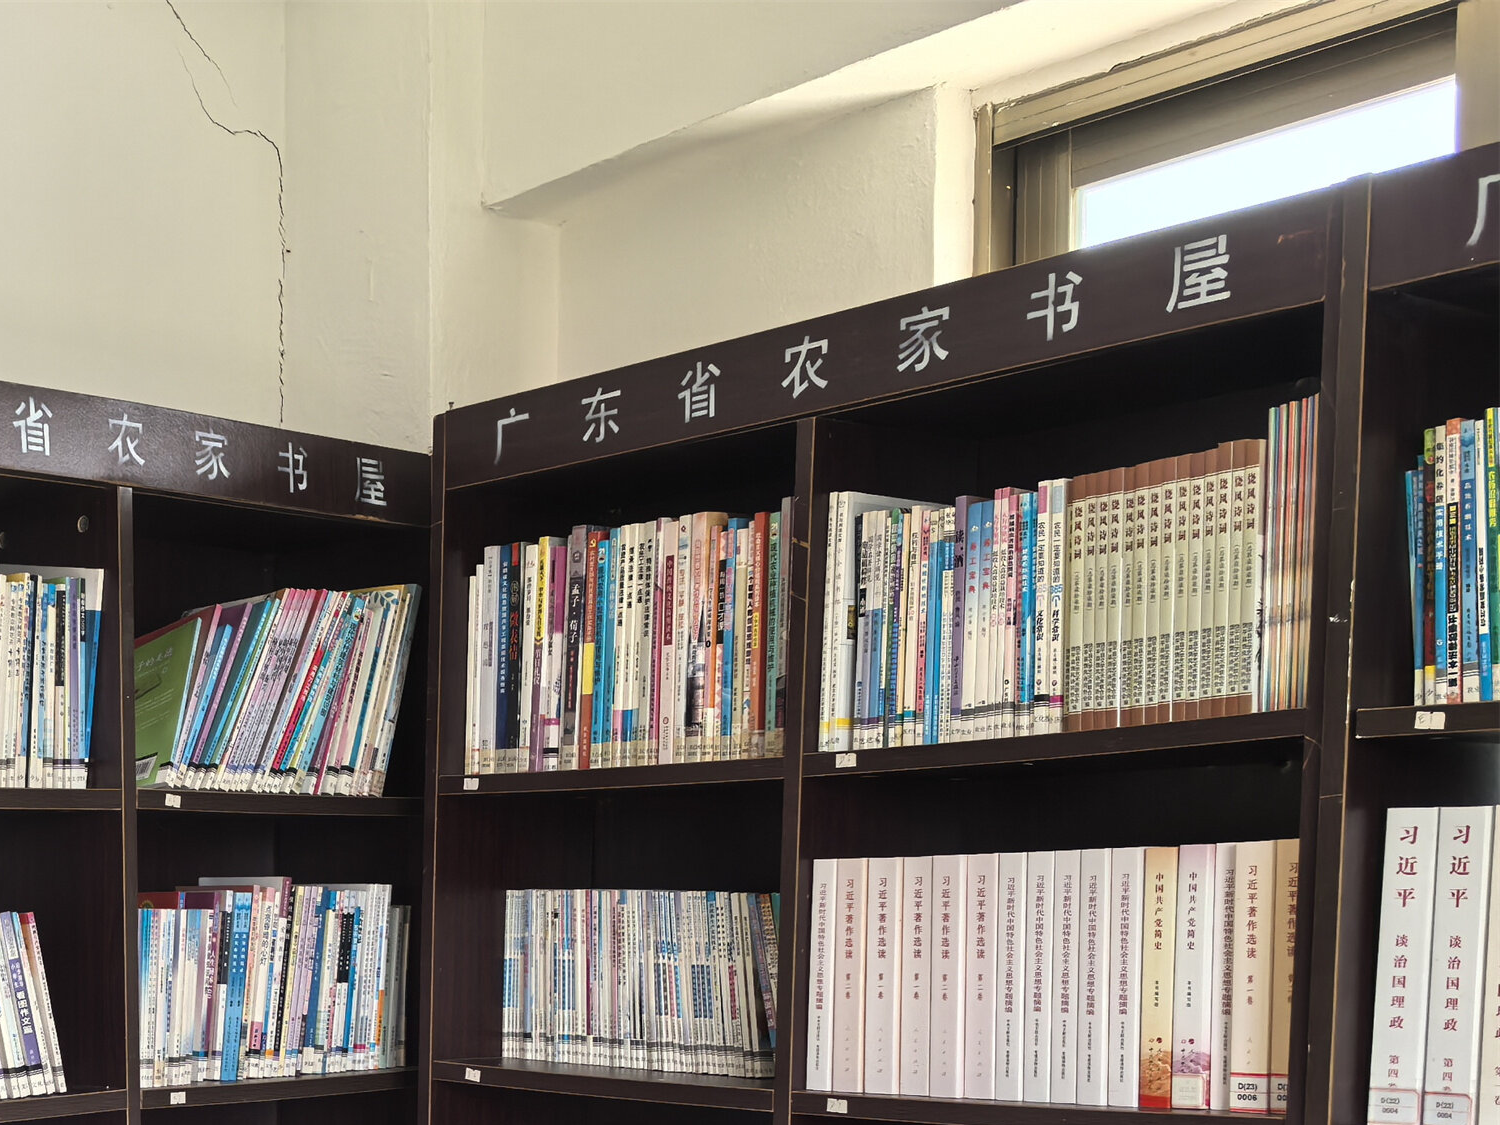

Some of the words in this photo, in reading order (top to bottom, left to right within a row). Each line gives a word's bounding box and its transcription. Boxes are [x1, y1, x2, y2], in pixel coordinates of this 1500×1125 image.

[494, 232, 1230, 465] 广东省农家书屋
[1393, 825, 1419, 908] 习近平
[1448, 825, 1472, 908] 习近平
[845, 879, 854, 960] 习近平著作选读
[878, 877, 887, 960] 习近平著作选读
[913, 876, 923, 959] 习近平著作选读
[941, 875, 951, 960] 习近平著作选读
[976, 875, 986, 960] 习近平著作选读
[1154, 872, 1164, 951] 中国共产党简史
[1187, 872, 1198, 951] 中国共产党简史
[1246, 865, 1258, 959] 习近平著作选读
[1389, 933, 1409, 1030] 谈治国理政
[1443, 935, 1463, 1033] 谈治国理政
